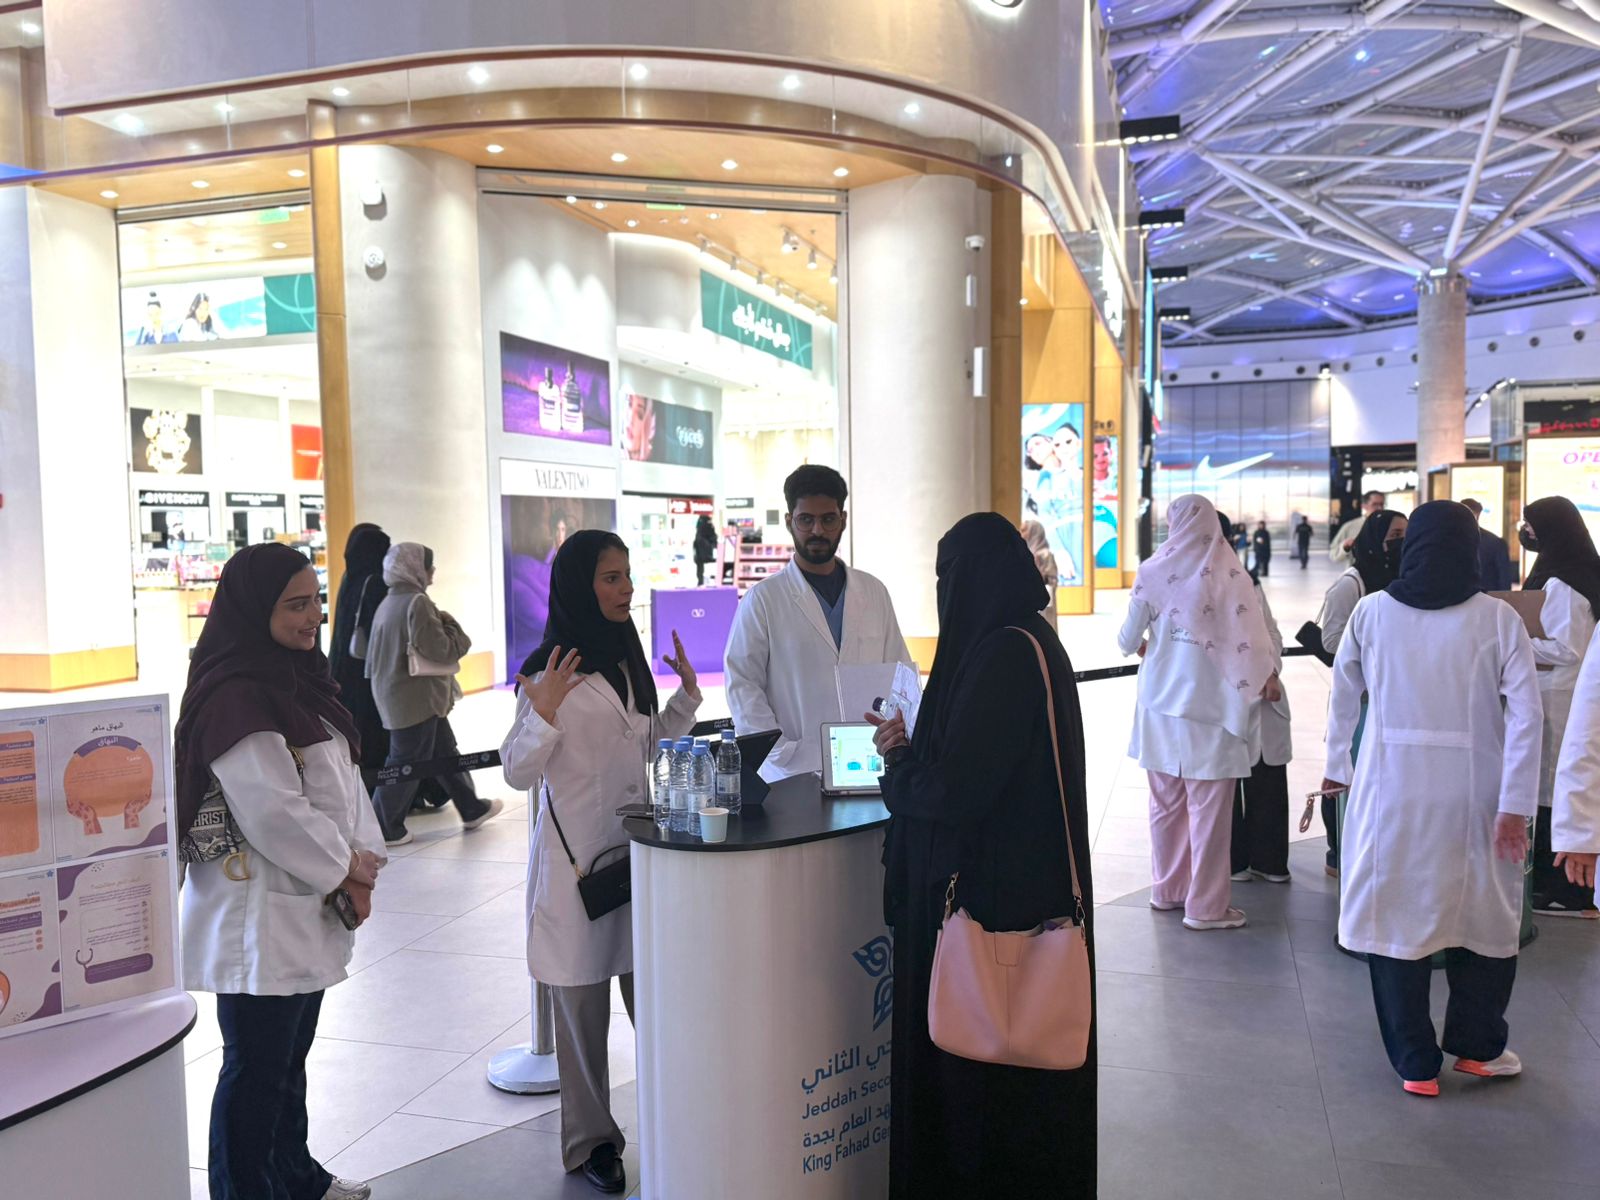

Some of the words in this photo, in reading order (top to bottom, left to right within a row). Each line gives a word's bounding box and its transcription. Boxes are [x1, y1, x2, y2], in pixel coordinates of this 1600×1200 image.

[534, 468, 592, 491] VALENTINO
[145, 492, 204, 504] GIVENCHY
[801, 1045, 860, 1094] الثاني
[802, 1087, 857, 1119] Jeddah
[803, 1127, 835, 1148] بجدة
[839, 1106, 871, 1142] العام
[803, 1153, 832, 1175] King
[835, 1132, 870, 1162] Fahad
